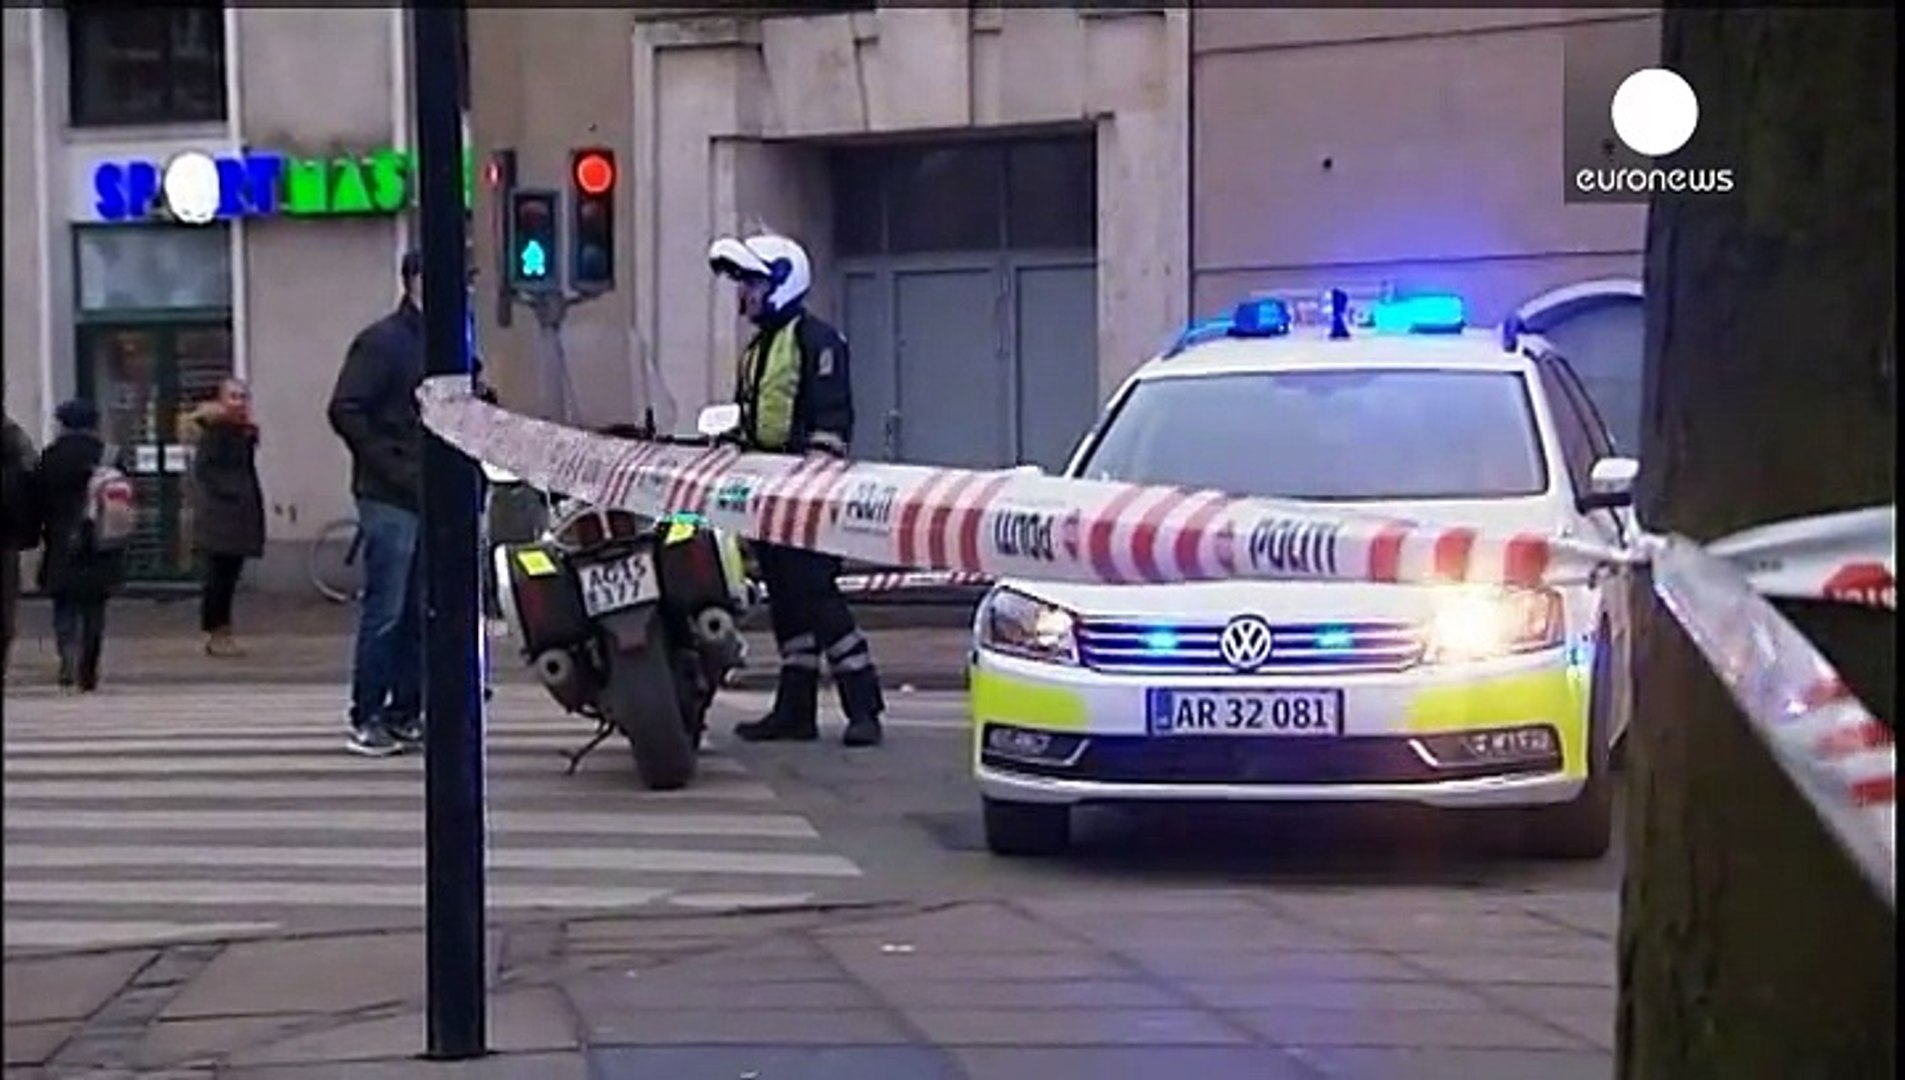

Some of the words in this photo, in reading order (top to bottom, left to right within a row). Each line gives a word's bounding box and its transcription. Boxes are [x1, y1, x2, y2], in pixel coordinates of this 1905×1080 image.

[1176, 697, 1217, 729] AR
[1225, 697, 1264, 729] 32
[1271, 697, 1328, 729] 081
